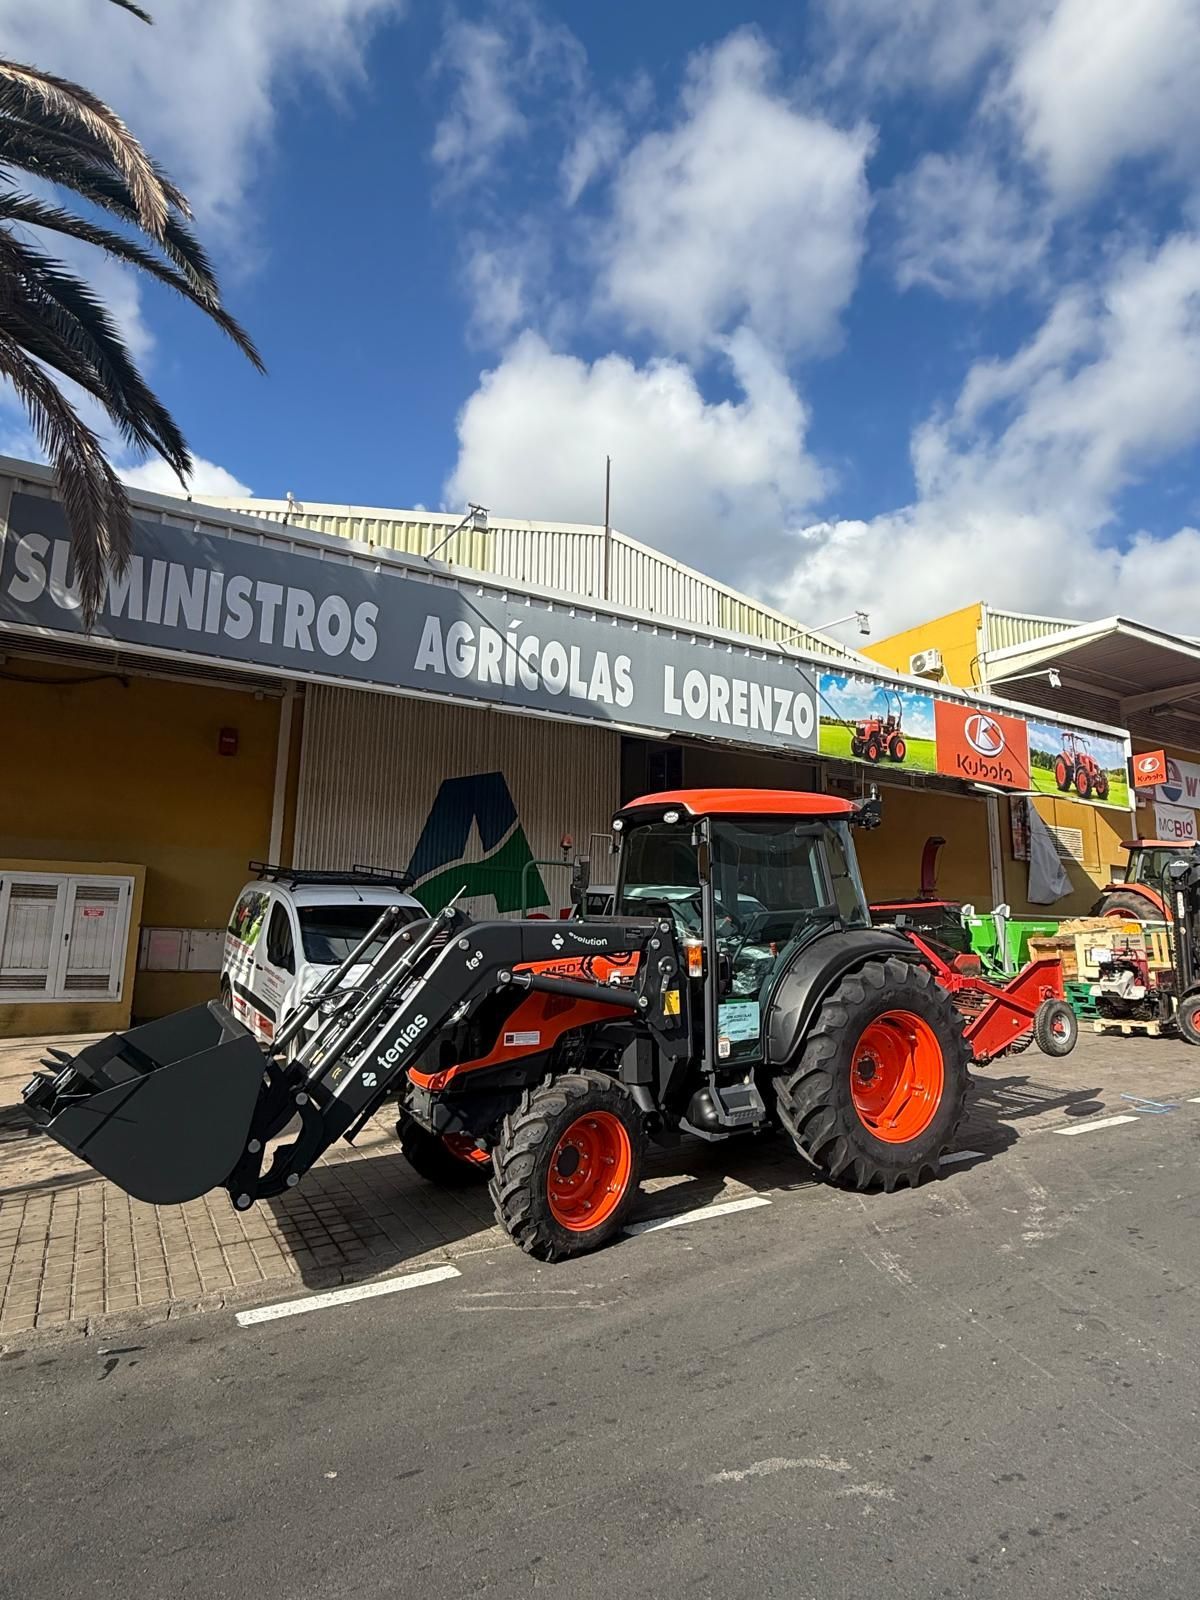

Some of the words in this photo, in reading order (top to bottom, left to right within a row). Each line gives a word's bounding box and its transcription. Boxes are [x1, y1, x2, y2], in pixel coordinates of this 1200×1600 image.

[7, 532, 380, 662] SUMINISTROS
[413, 614, 634, 708] AGRÍCOLAS
[664, 664, 815, 739] LORENZO
[957, 753, 1013, 783] Kubota
[1137, 773, 1164, 782] Kubota
[568, 931, 608, 946] evolution
